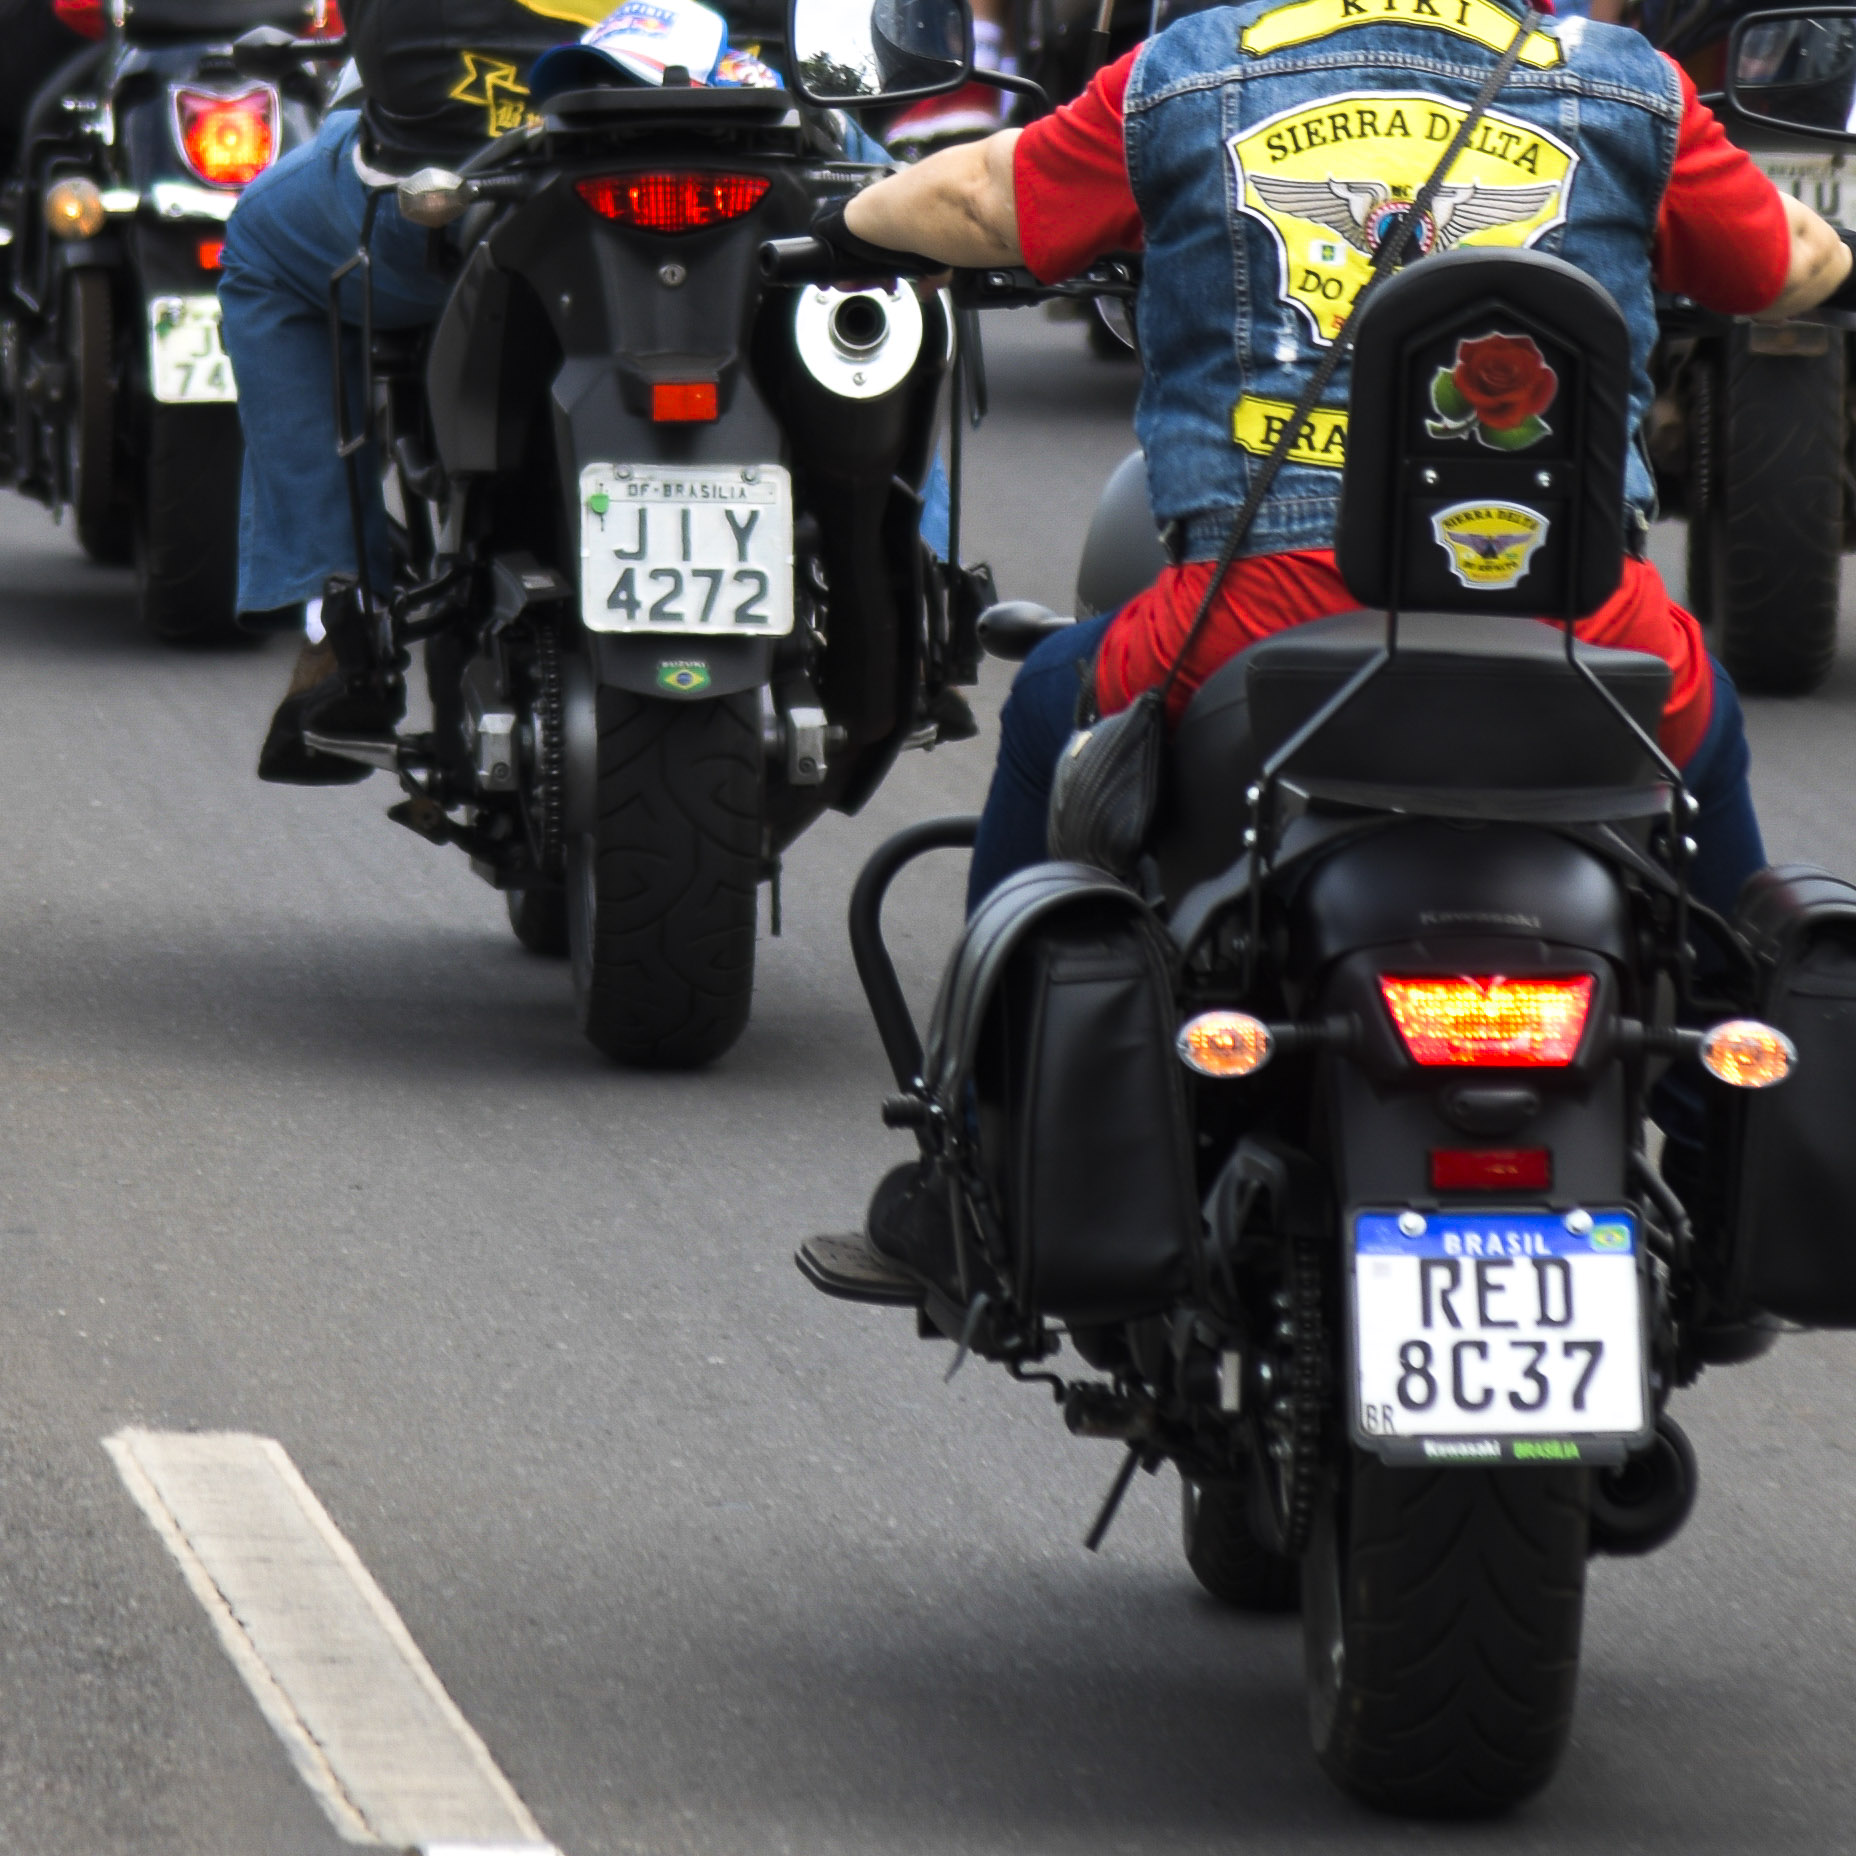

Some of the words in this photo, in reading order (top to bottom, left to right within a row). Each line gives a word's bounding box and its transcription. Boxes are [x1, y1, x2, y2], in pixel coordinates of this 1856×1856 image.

[1266, 109, 1409, 163] SIERRA
[1298, 269, 1344, 301] DO
[175, 362, 228, 395] 74
[1260, 414, 1347, 455] BRA
[613, 507, 761, 563] JIY
[606, 566, 770, 625] 4272
[1443, 1232, 1552, 1257] BRASIL
[1419, 1257, 1575, 1329] RED
[1396, 1339, 1605, 1412] 8C37
[1366, 1404, 1396, 1434] BR
[1424, 1440, 1502, 1458] Kawasaki
